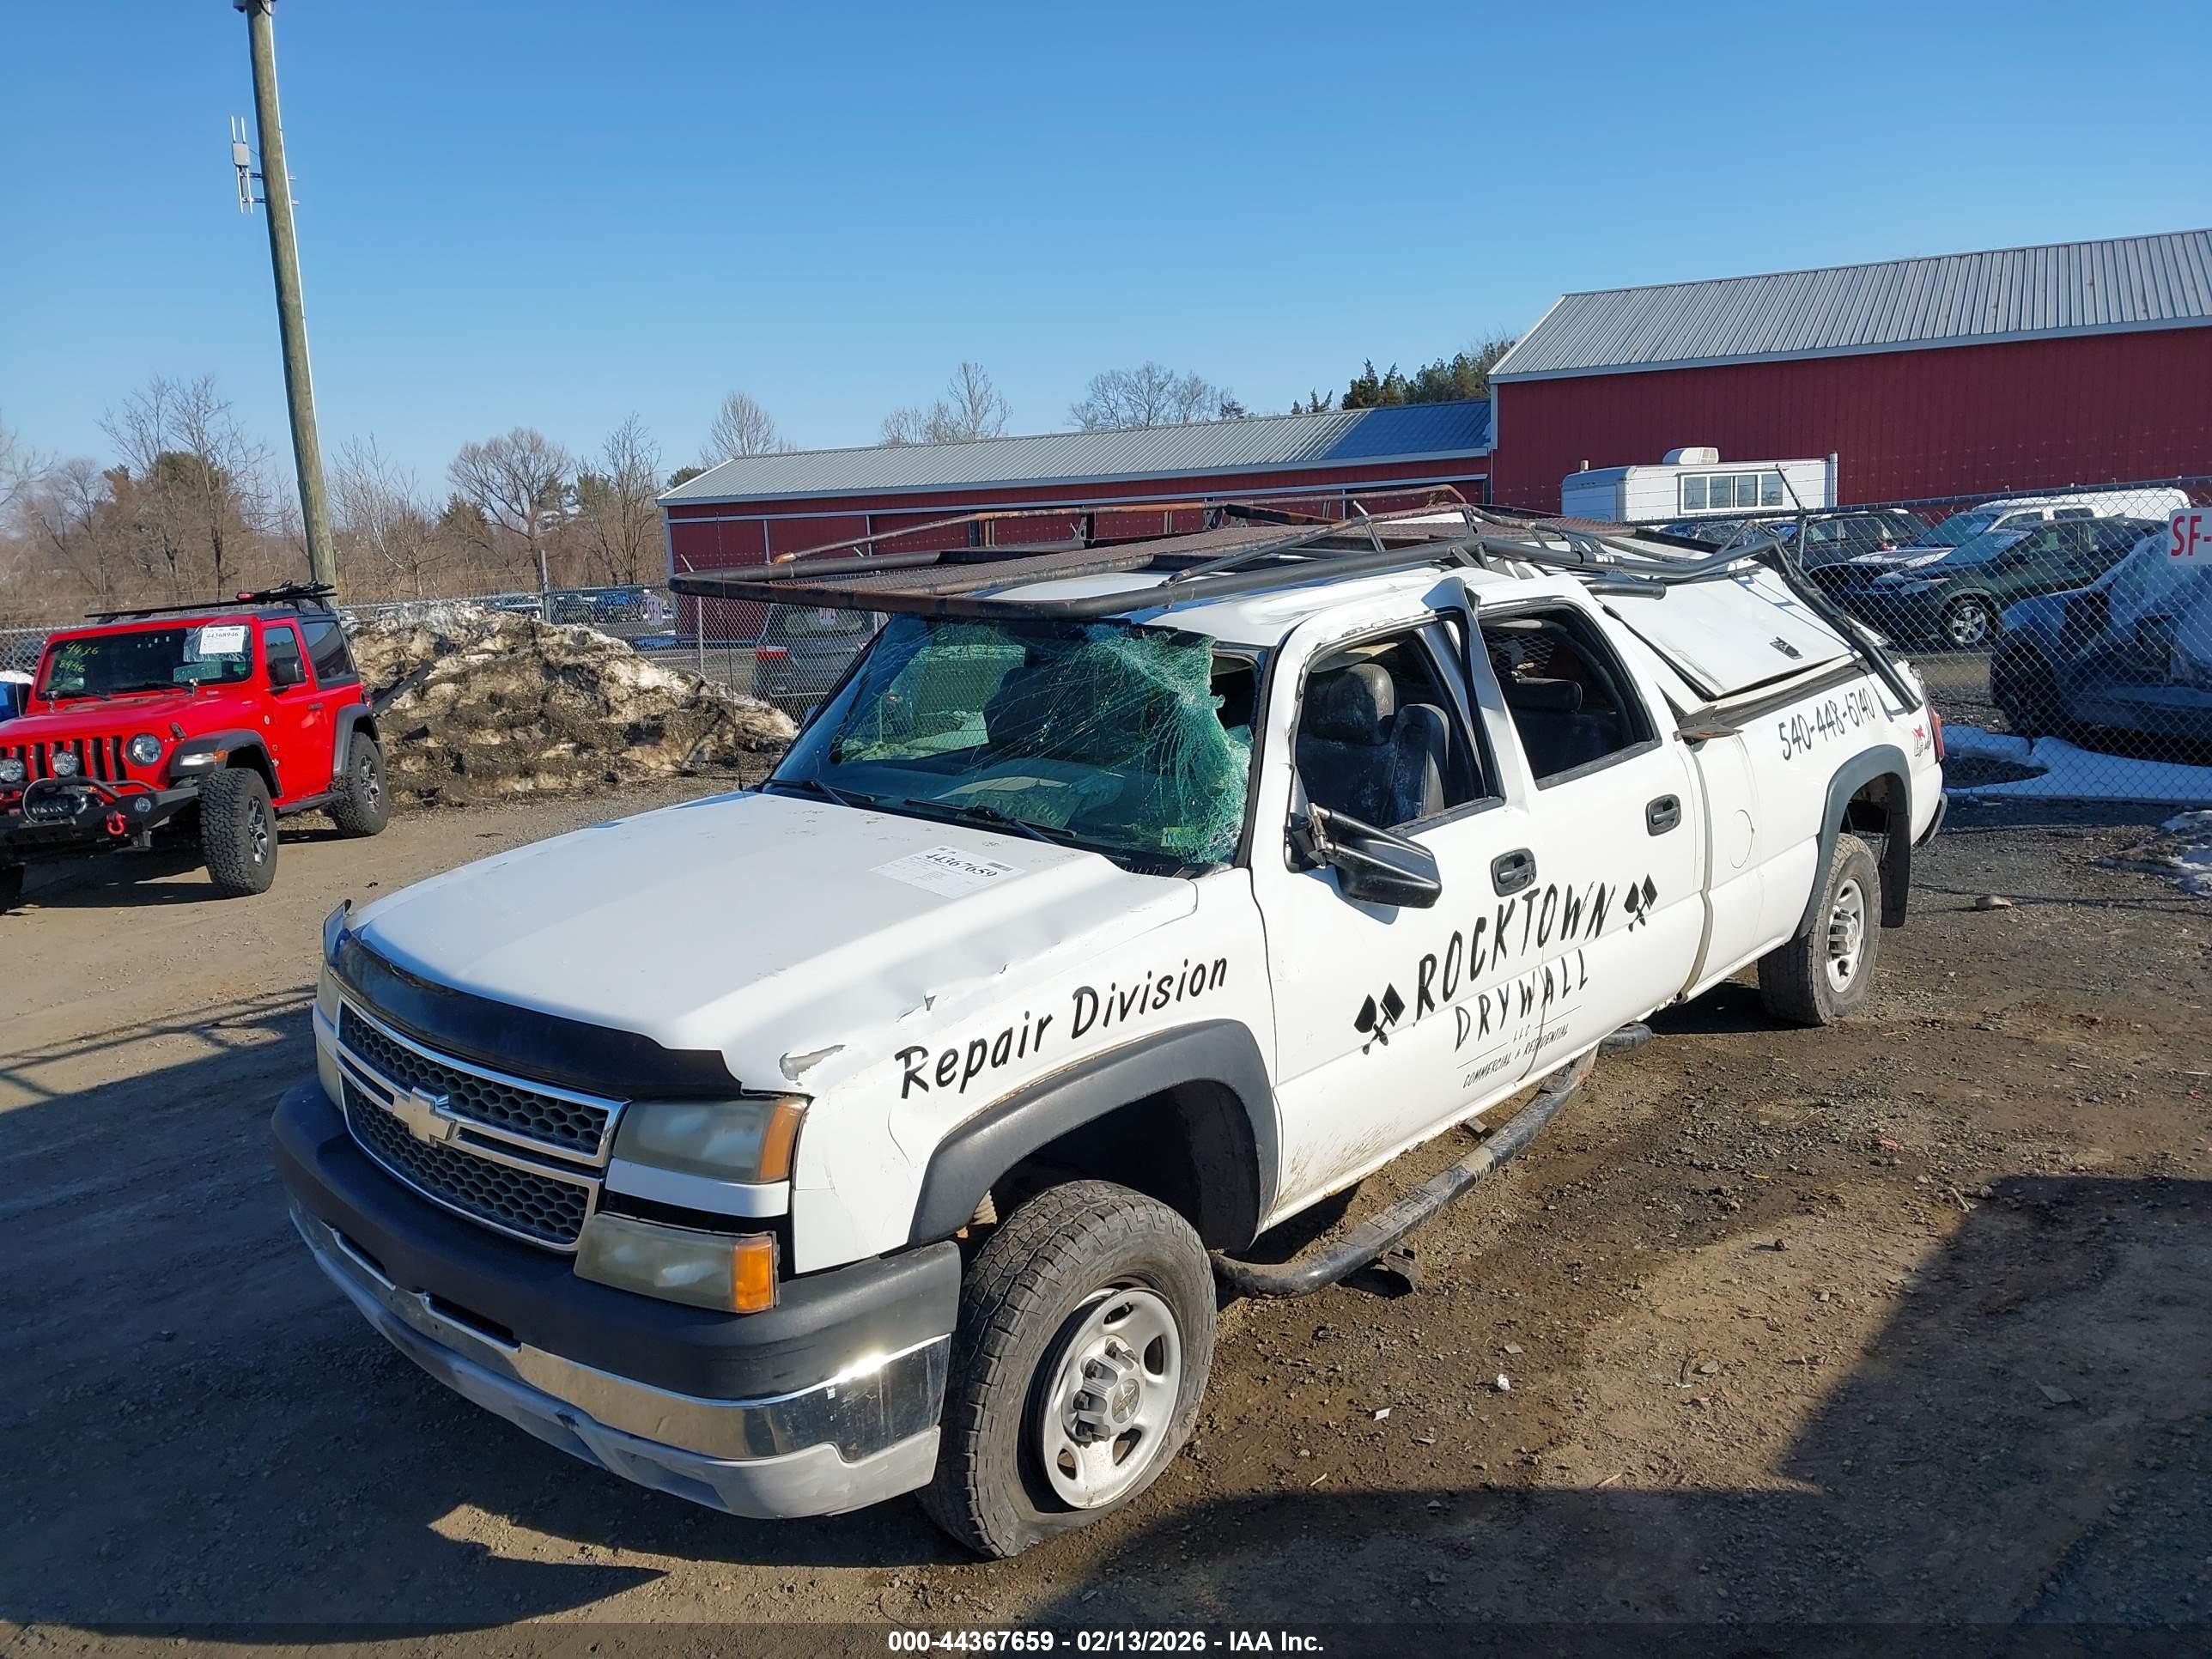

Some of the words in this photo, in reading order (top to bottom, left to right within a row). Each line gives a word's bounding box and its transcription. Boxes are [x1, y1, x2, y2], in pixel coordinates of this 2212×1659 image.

[1778, 687, 1875, 761] 540-448-6740
[924, 852, 999, 878] 44367659
[1413, 880, 1616, 1026] ROCKTOWN
[894, 1011, 1053, 1100] Repair
[1072, 957, 1228, 1040] Division
[1454, 947, 1589, 1054] DRYWALL
[1512, 1023, 1531, 1044] LLC
[1462, 1050, 1512, 1089] COMMERCIAL
